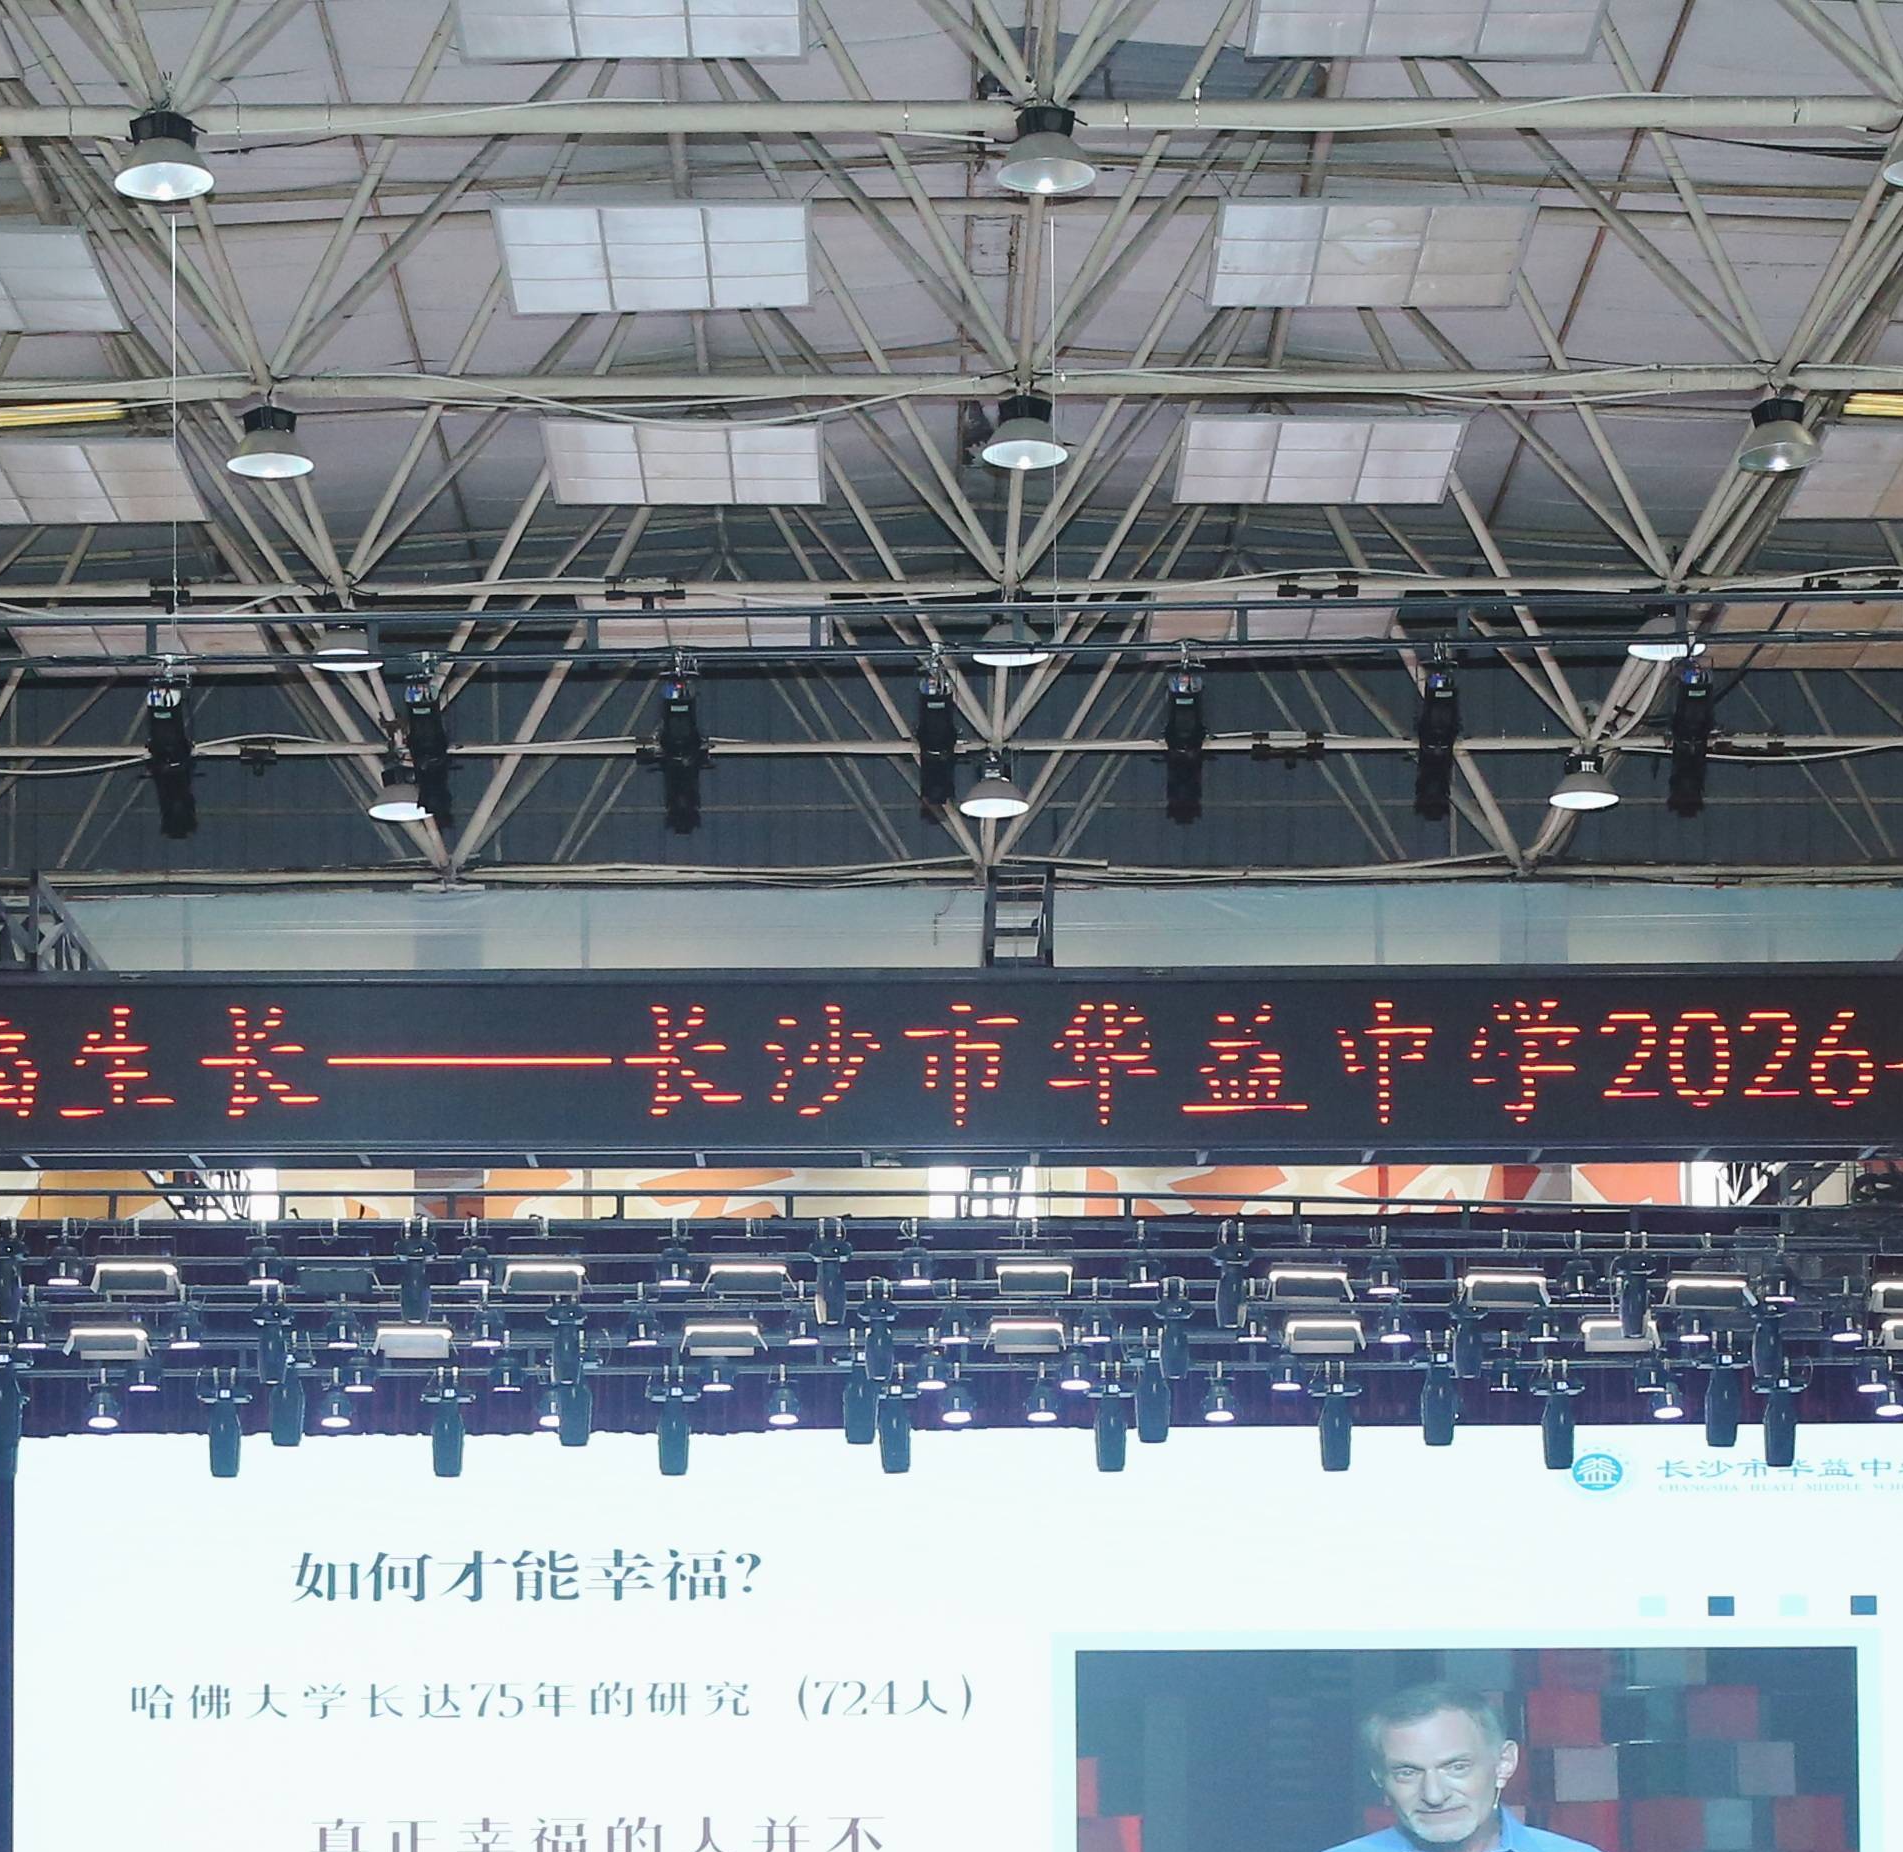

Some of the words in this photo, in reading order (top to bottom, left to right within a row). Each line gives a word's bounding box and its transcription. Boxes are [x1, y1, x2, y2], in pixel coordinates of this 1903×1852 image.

[290, 1548, 763, 1603] 如何才能幸福？
